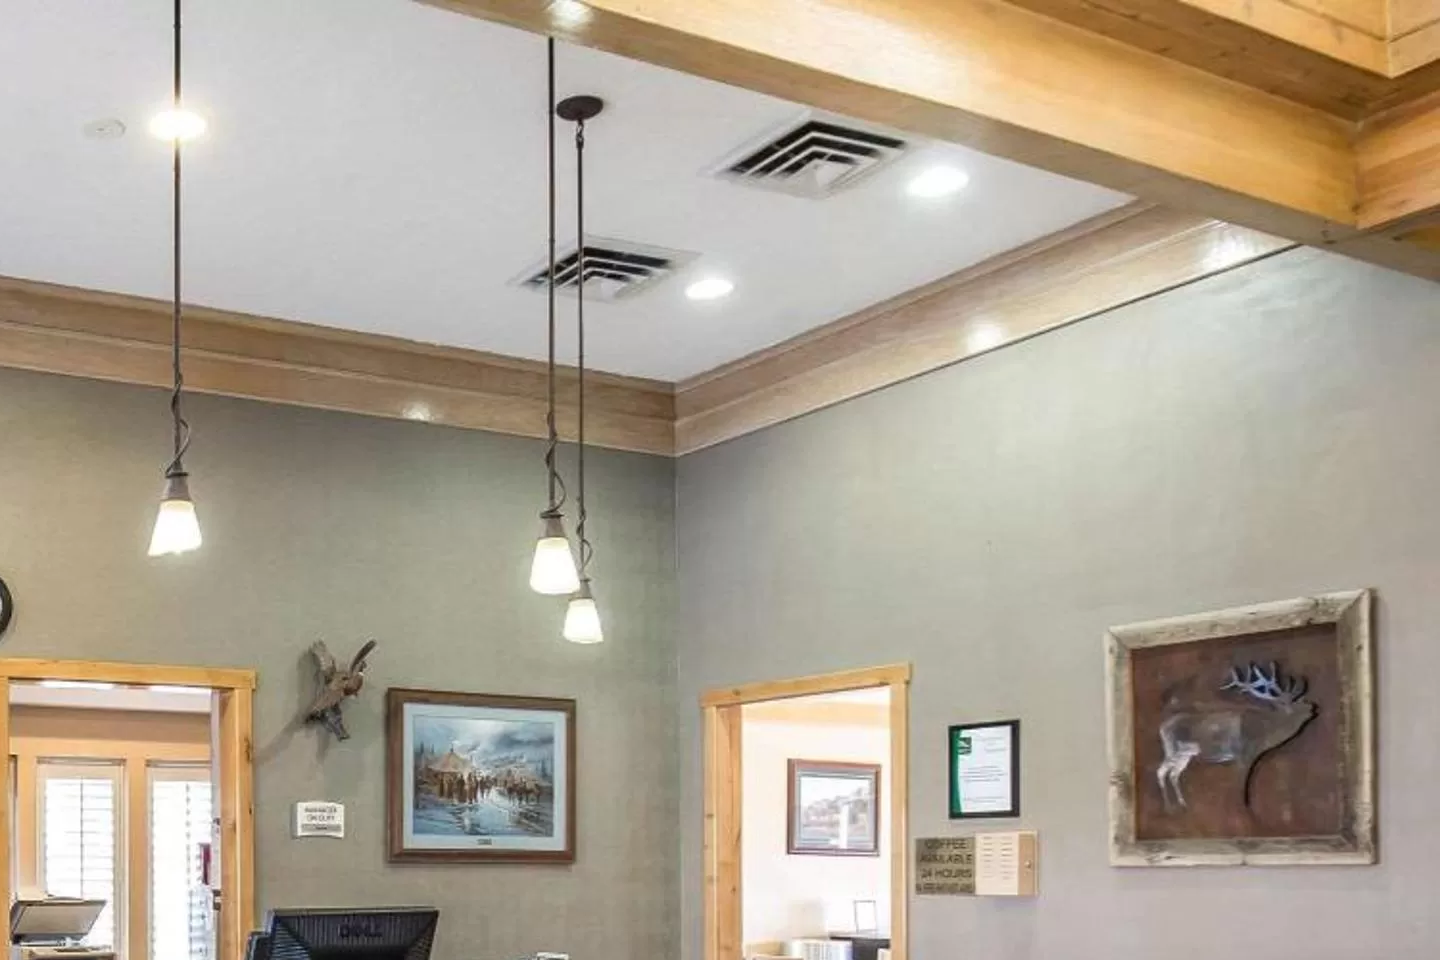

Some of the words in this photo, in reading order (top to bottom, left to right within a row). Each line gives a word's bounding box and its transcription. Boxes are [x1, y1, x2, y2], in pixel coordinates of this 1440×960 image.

[924, 838, 968, 850] COFFEE
[920, 853, 973, 865] AVAILABLE
[920, 868, 933, 878] 24
[935, 868, 973, 878] HOURS
